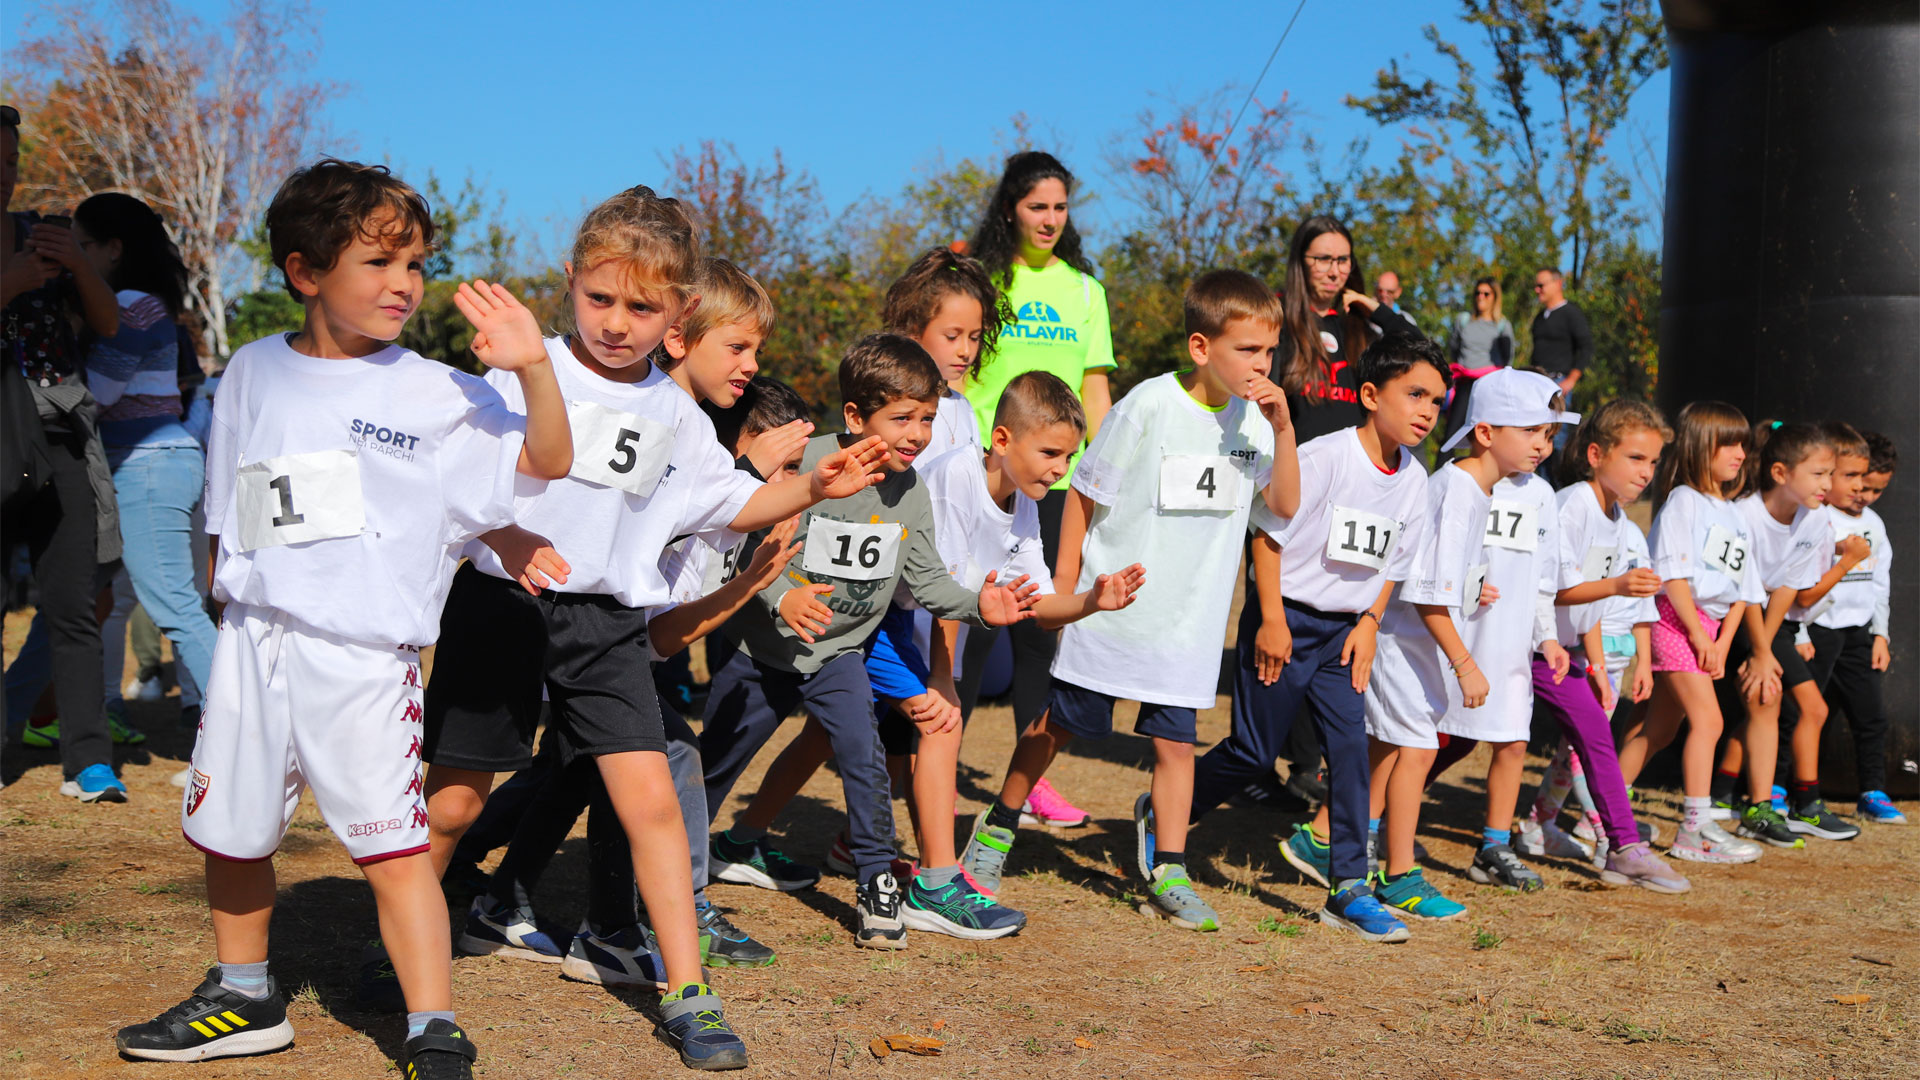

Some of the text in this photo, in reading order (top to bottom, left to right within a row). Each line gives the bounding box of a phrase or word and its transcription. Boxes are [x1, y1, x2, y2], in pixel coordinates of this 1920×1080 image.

[1001, 324, 1078, 343] ATLAVIR
[351, 418, 420, 451] SPORT
[370, 442, 415, 463] PARCHI
[608, 427, 641, 474] 5
[1196, 467, 1216, 498] 4
[269, 474, 305, 527] 1
[1486, 509, 1523, 539] 17
[831, 534, 882, 569] 16
[1341, 520, 1391, 560] 111
[1601, 556, 1612, 579] 3
[1719, 541, 1745, 571] 13
[347, 818, 402, 837] Kappa
